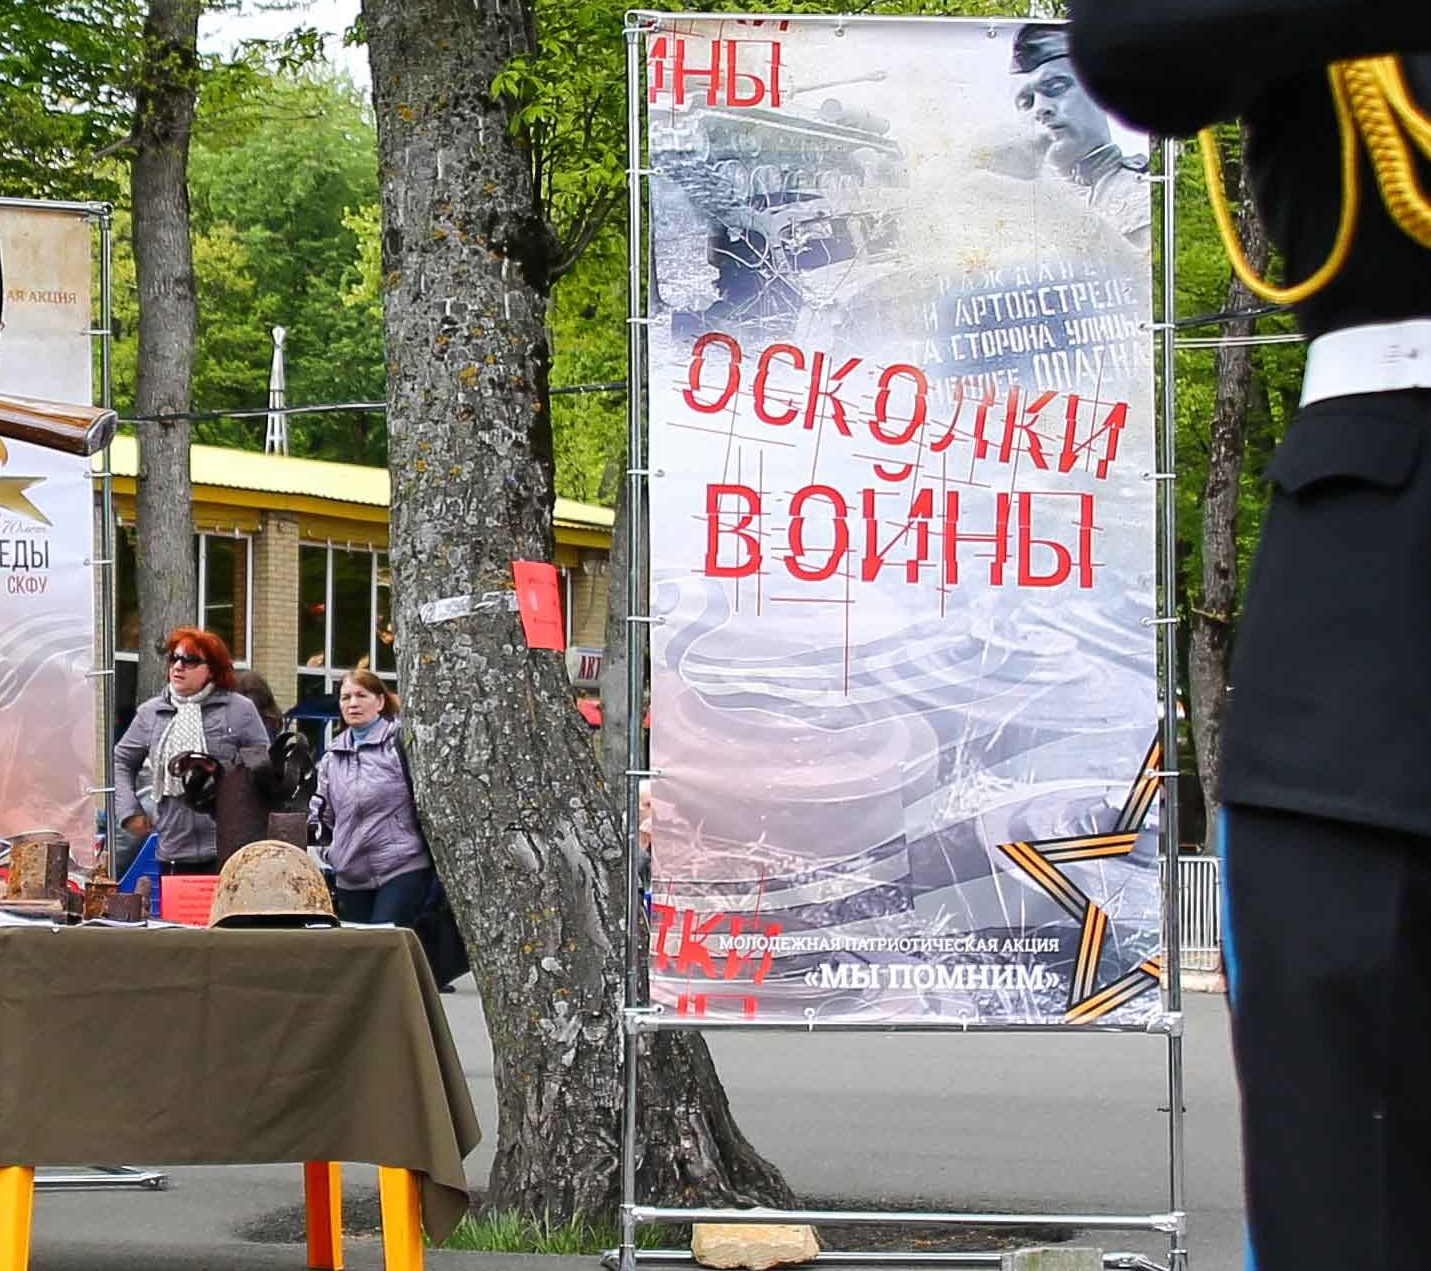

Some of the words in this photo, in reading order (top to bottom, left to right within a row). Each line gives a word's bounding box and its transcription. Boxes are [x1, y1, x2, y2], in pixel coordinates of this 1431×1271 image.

[951, 322, 1056, 361] СТОРОНА
[683, 331, 1129, 480] ОСКОЛКИ
[704, 464, 1095, 589] ВОЙНЫ
[7, 576, 48, 595] СКФУ
[719, 935, 842, 954] МОЛОДЕЖНАЯ
[844, 935, 999, 954] ПАТРИОТИЧЕСКАЯ
[1001, 935, 1060, 954] АКЦИЯ
[803, 962, 879, 991] «МЫ
[883, 962, 1060, 991] ПОМНИМ»
